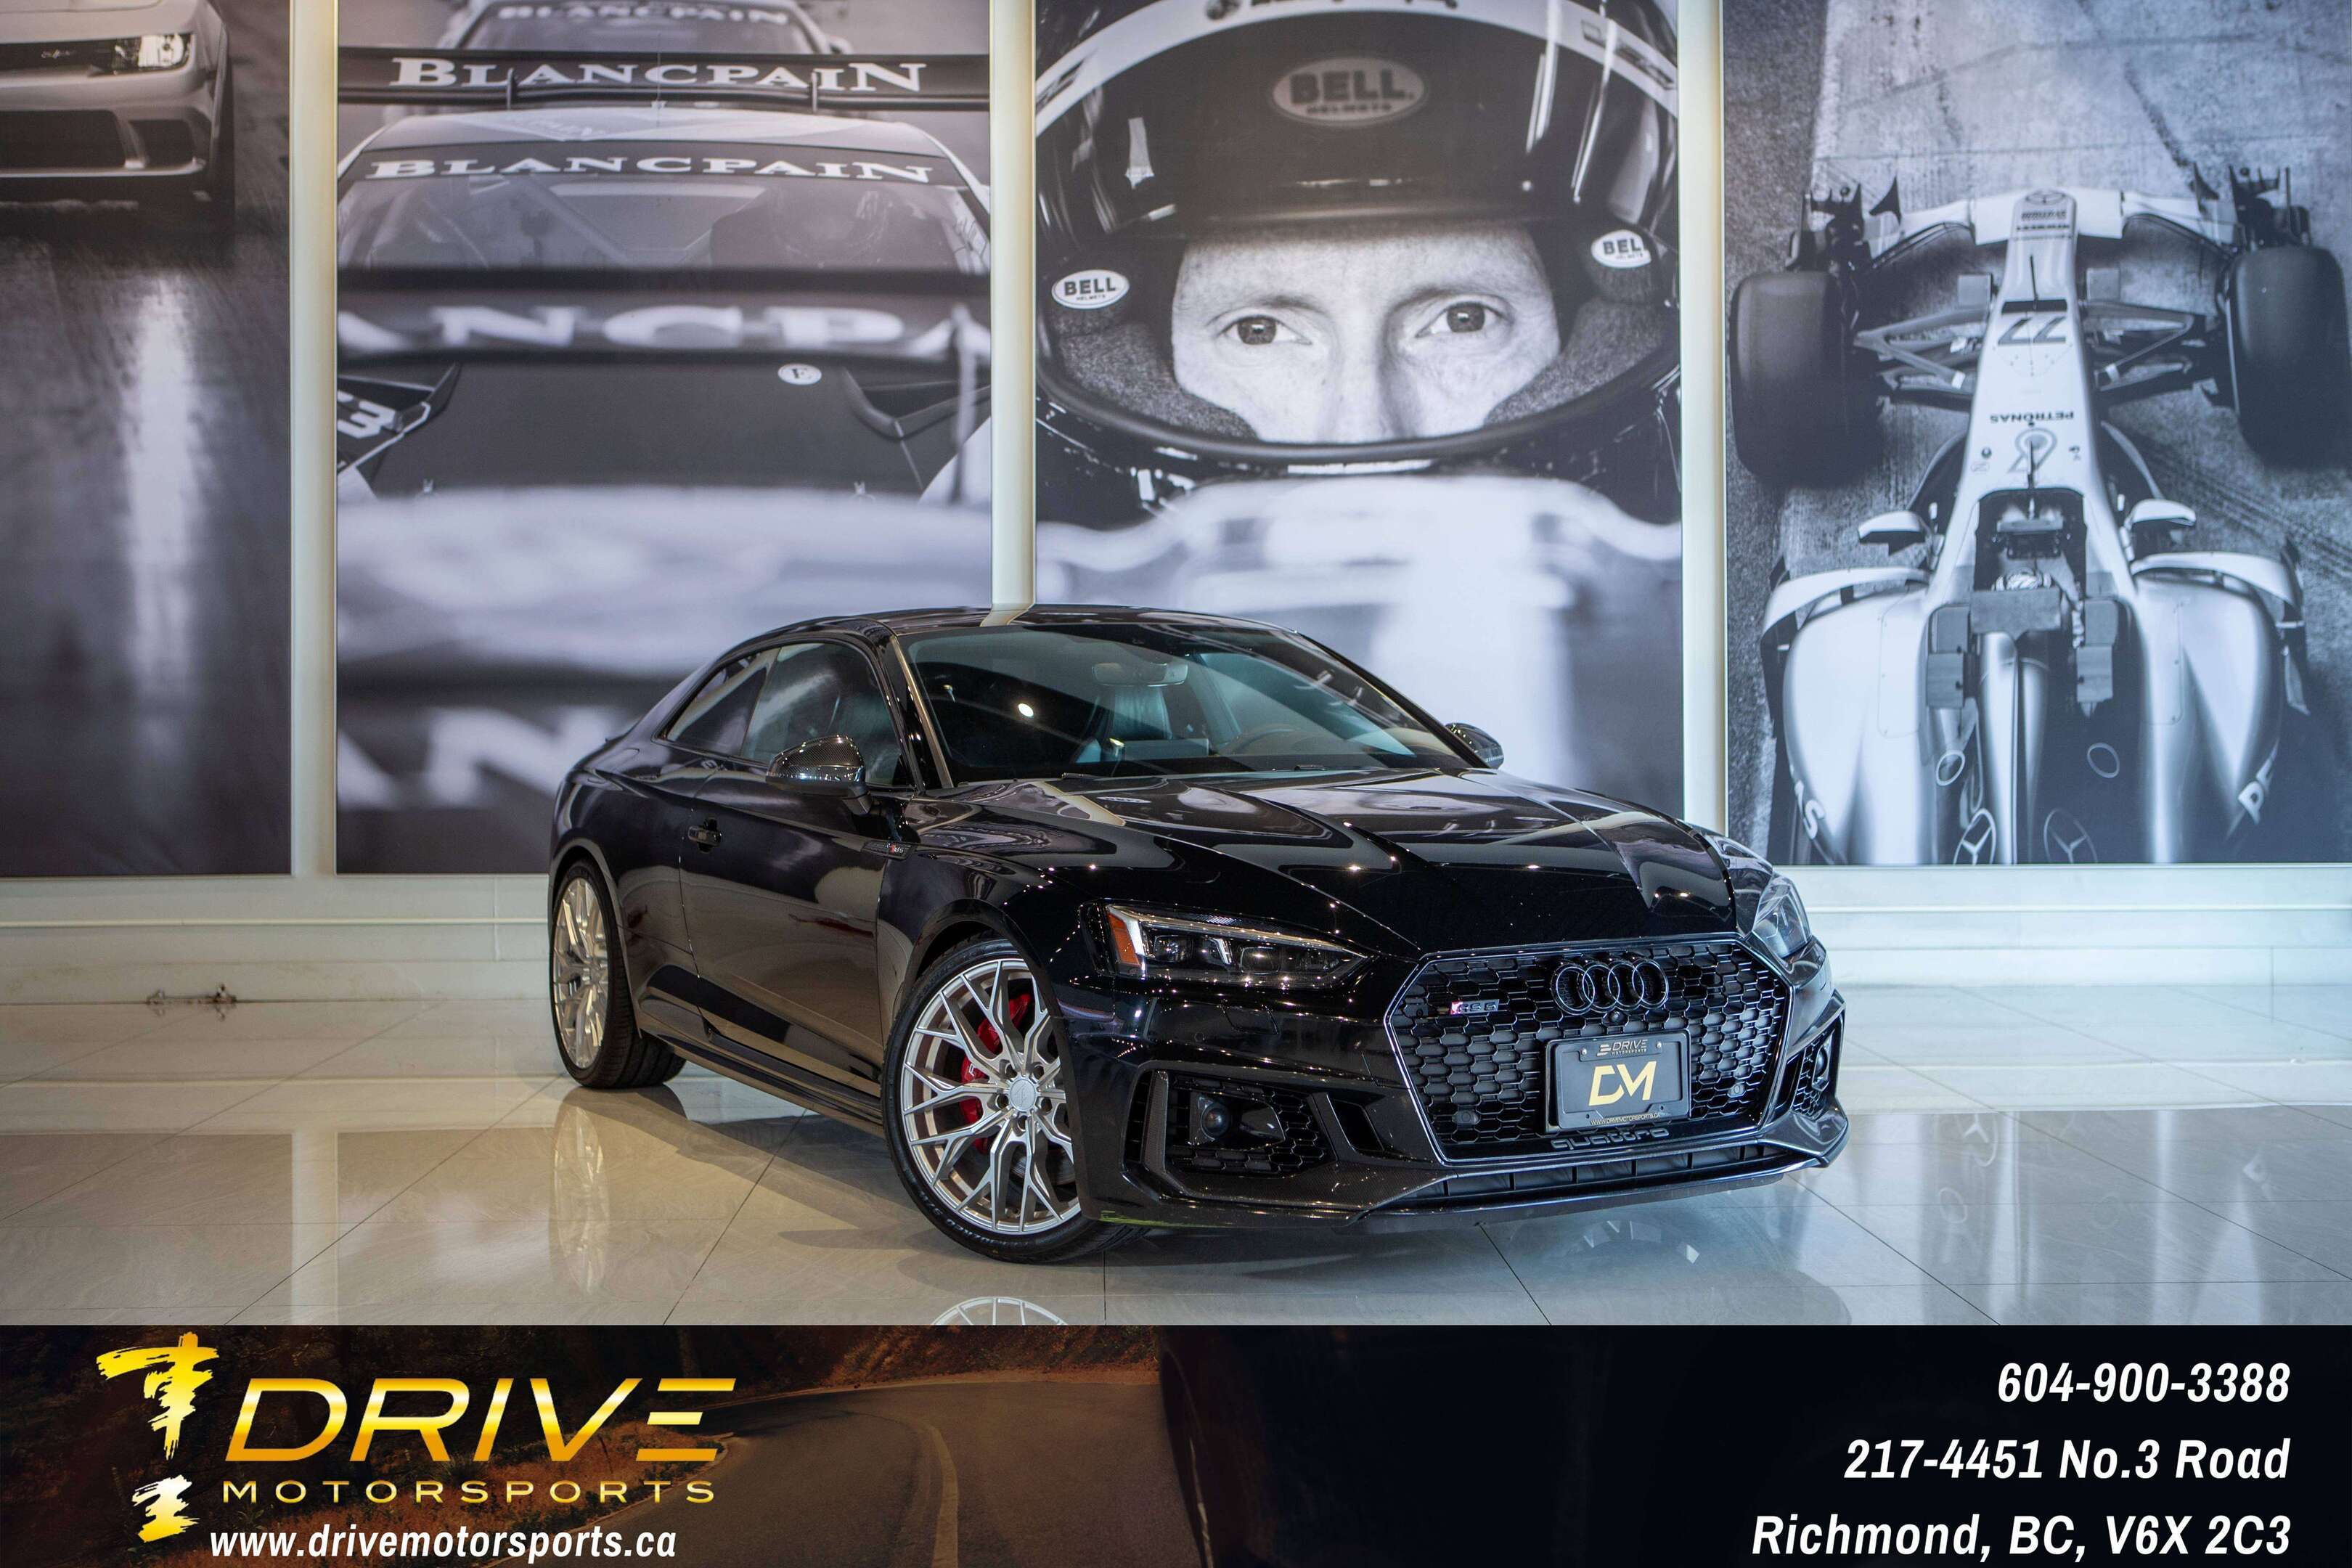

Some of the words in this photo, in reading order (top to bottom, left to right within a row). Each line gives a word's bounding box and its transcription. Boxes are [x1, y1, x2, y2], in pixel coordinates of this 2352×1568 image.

[389, 57, 927, 92] BLANCPAIN
[1289, 69, 1407, 105] BELL
[365, 157, 933, 184] BLANCPAIN
[1602, 237, 1642, 255] BEL
[1063, 277, 1116, 296] BELL
[1989, 410, 2075, 424] PETRONAS
[1612, 1039, 1648, 1051] DRIVE
[1588, 1061, 1657, 1106] DM
[1551, 1127, 1670, 1151] quattro
